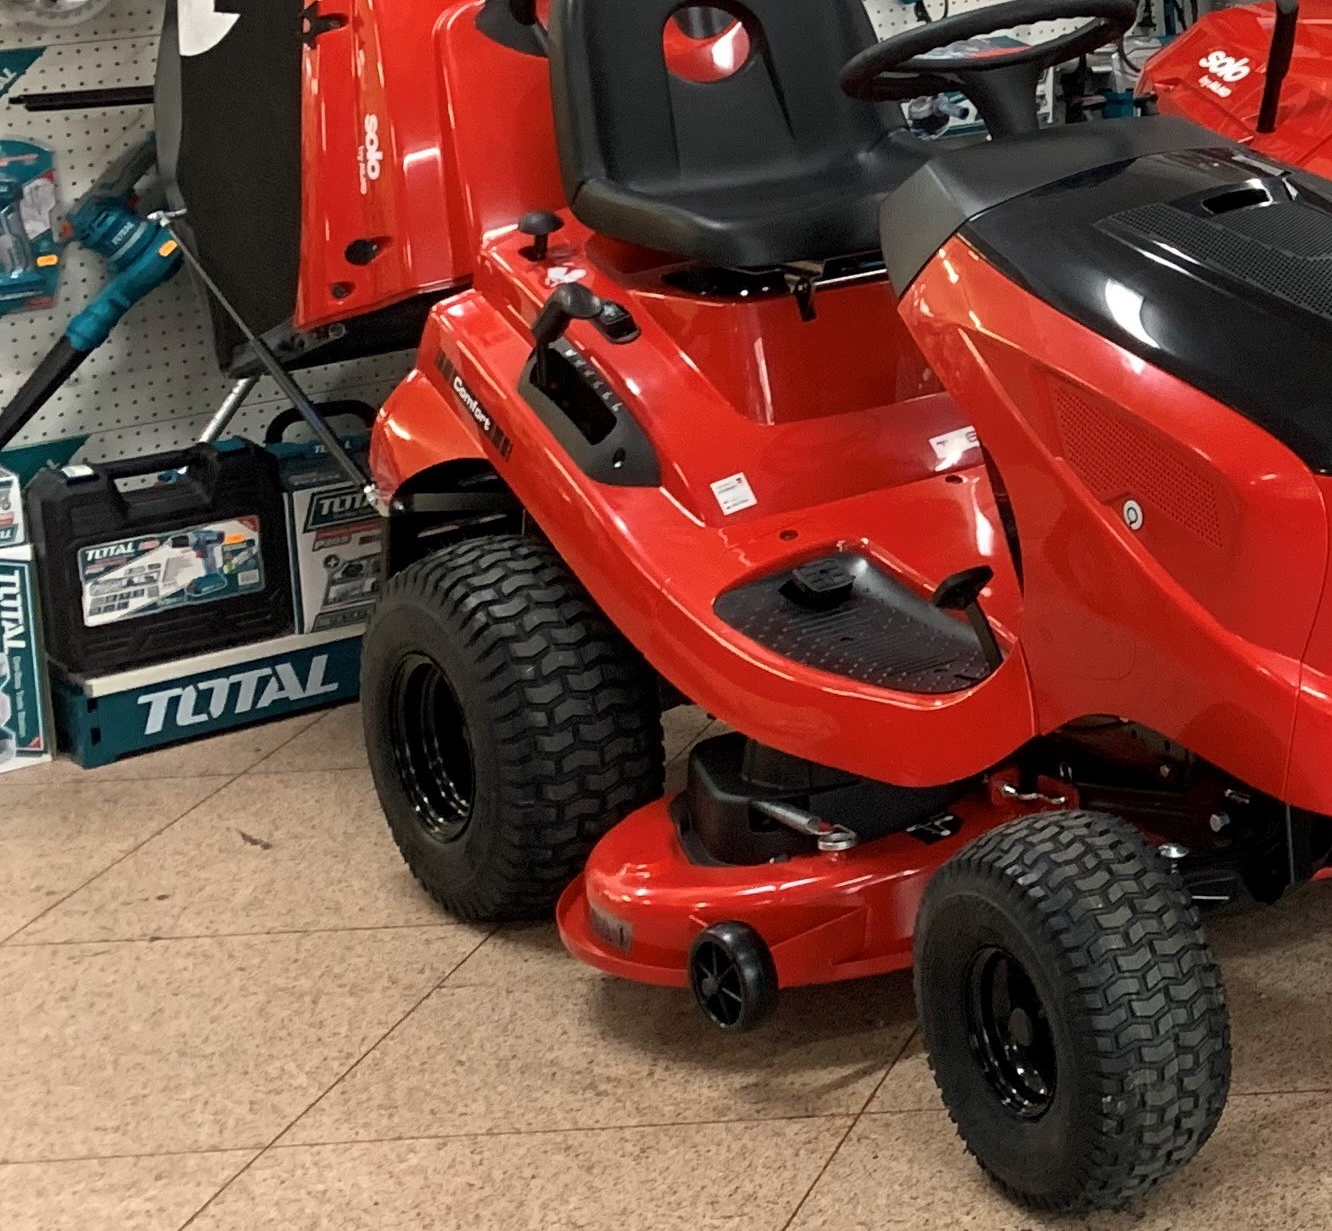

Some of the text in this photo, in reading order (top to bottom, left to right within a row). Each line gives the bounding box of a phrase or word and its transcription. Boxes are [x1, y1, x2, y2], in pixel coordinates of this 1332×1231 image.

[1198, 50, 1251, 83] solo
[365, 113, 384, 181] solo
[453, 375, 491, 431] Comfort
[85, 542, 136, 562] TOTAL
[0, 569, 27, 650] TOTAL
[137, 653, 339, 736] TOTAL
